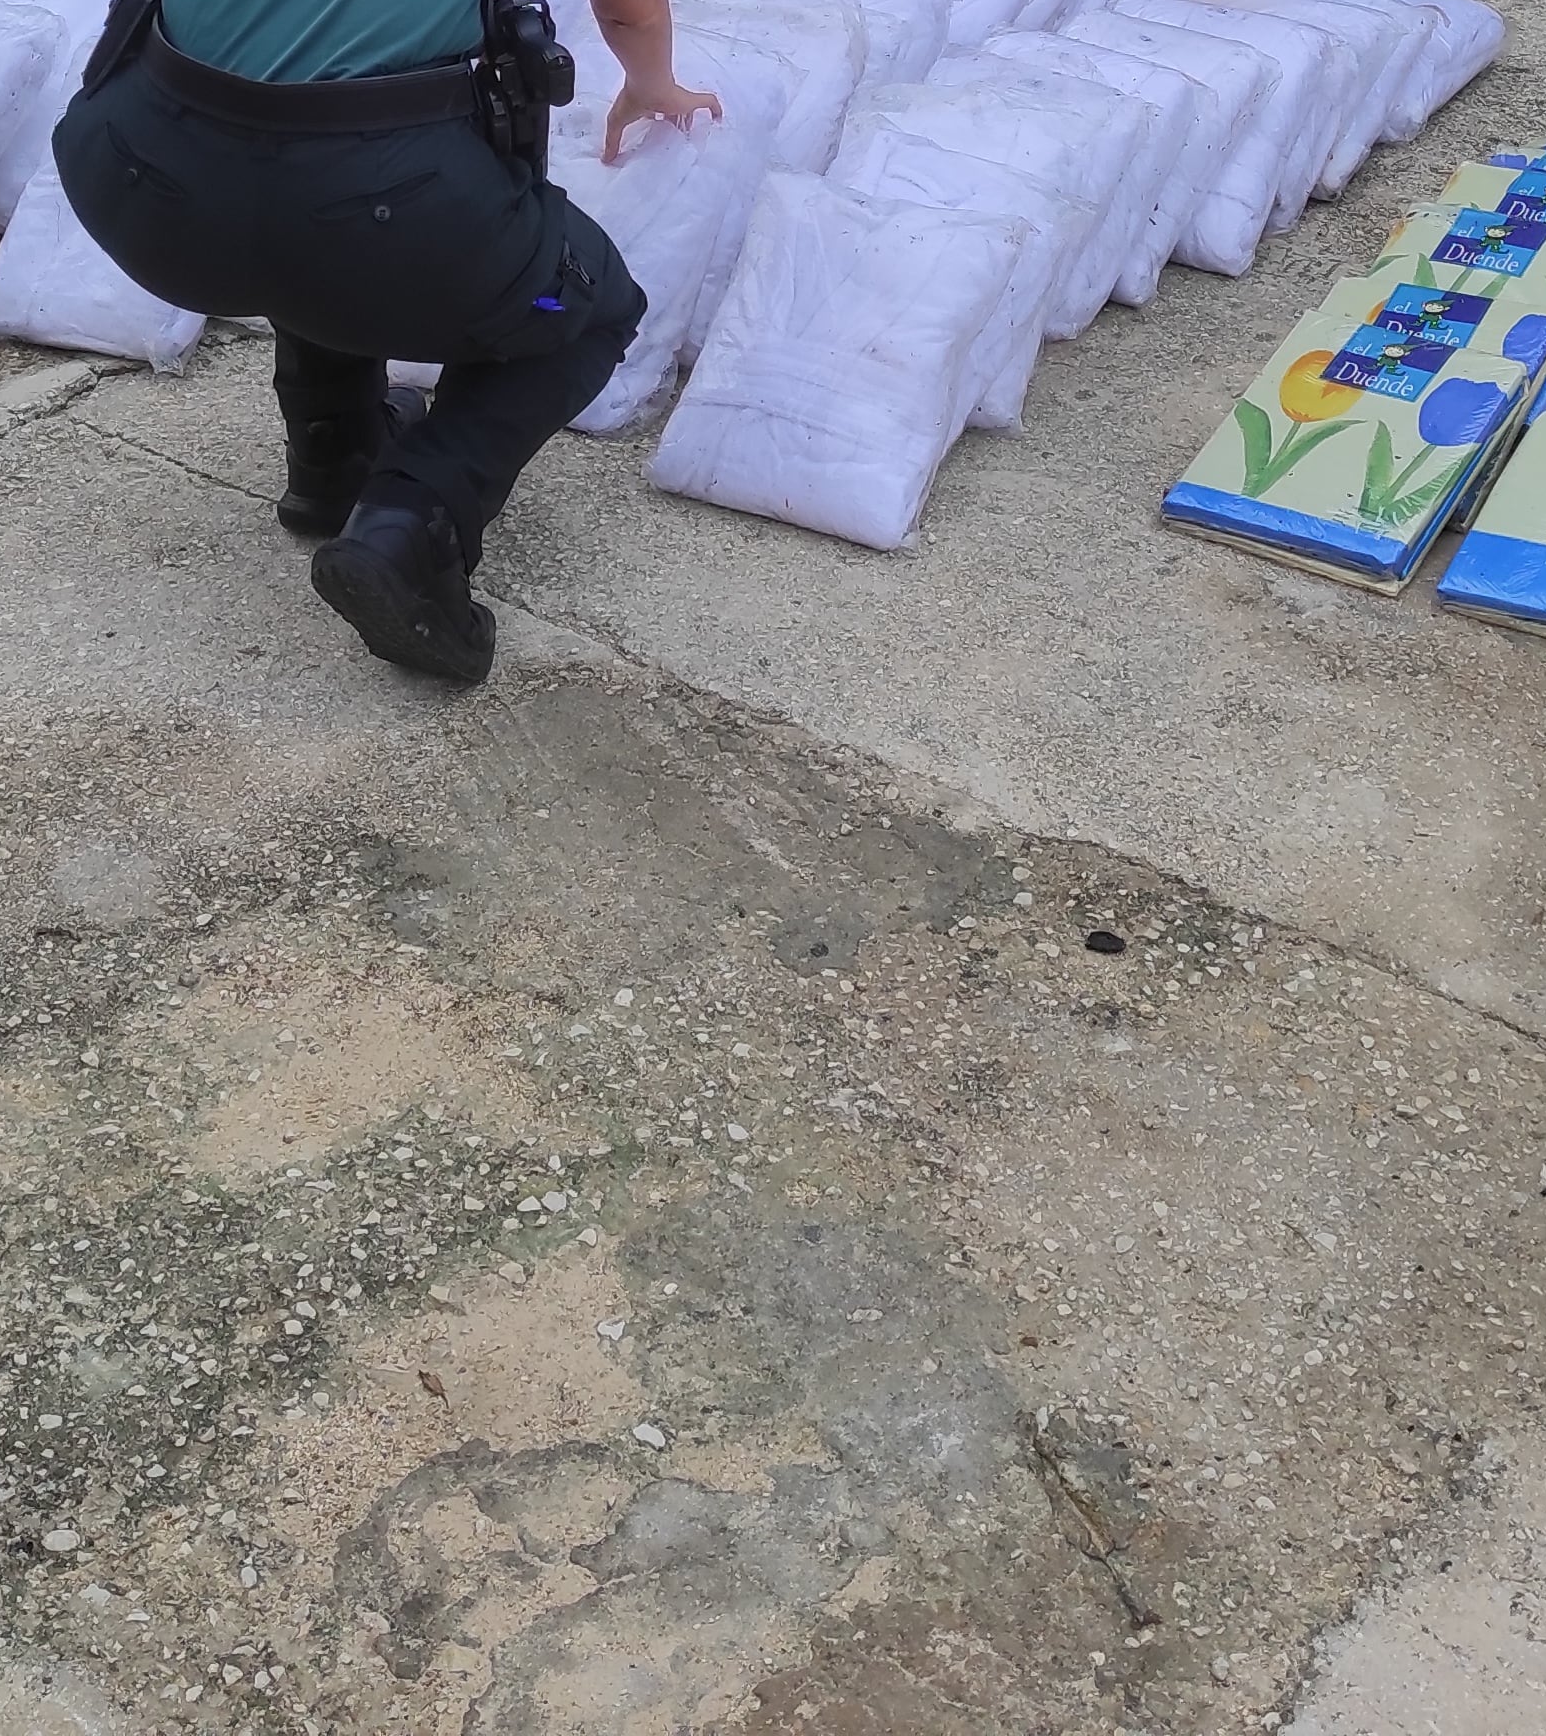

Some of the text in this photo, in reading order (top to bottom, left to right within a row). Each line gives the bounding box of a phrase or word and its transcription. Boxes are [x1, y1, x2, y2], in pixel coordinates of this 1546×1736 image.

[1519, 187, 1535, 196] el
[1457, 227, 1474, 238] el
[1442, 243, 1520, 272] Duende
[1394, 301, 1413, 314] el
[1353, 343, 1372, 356] el
[1334, 361, 1414, 398] Duende
